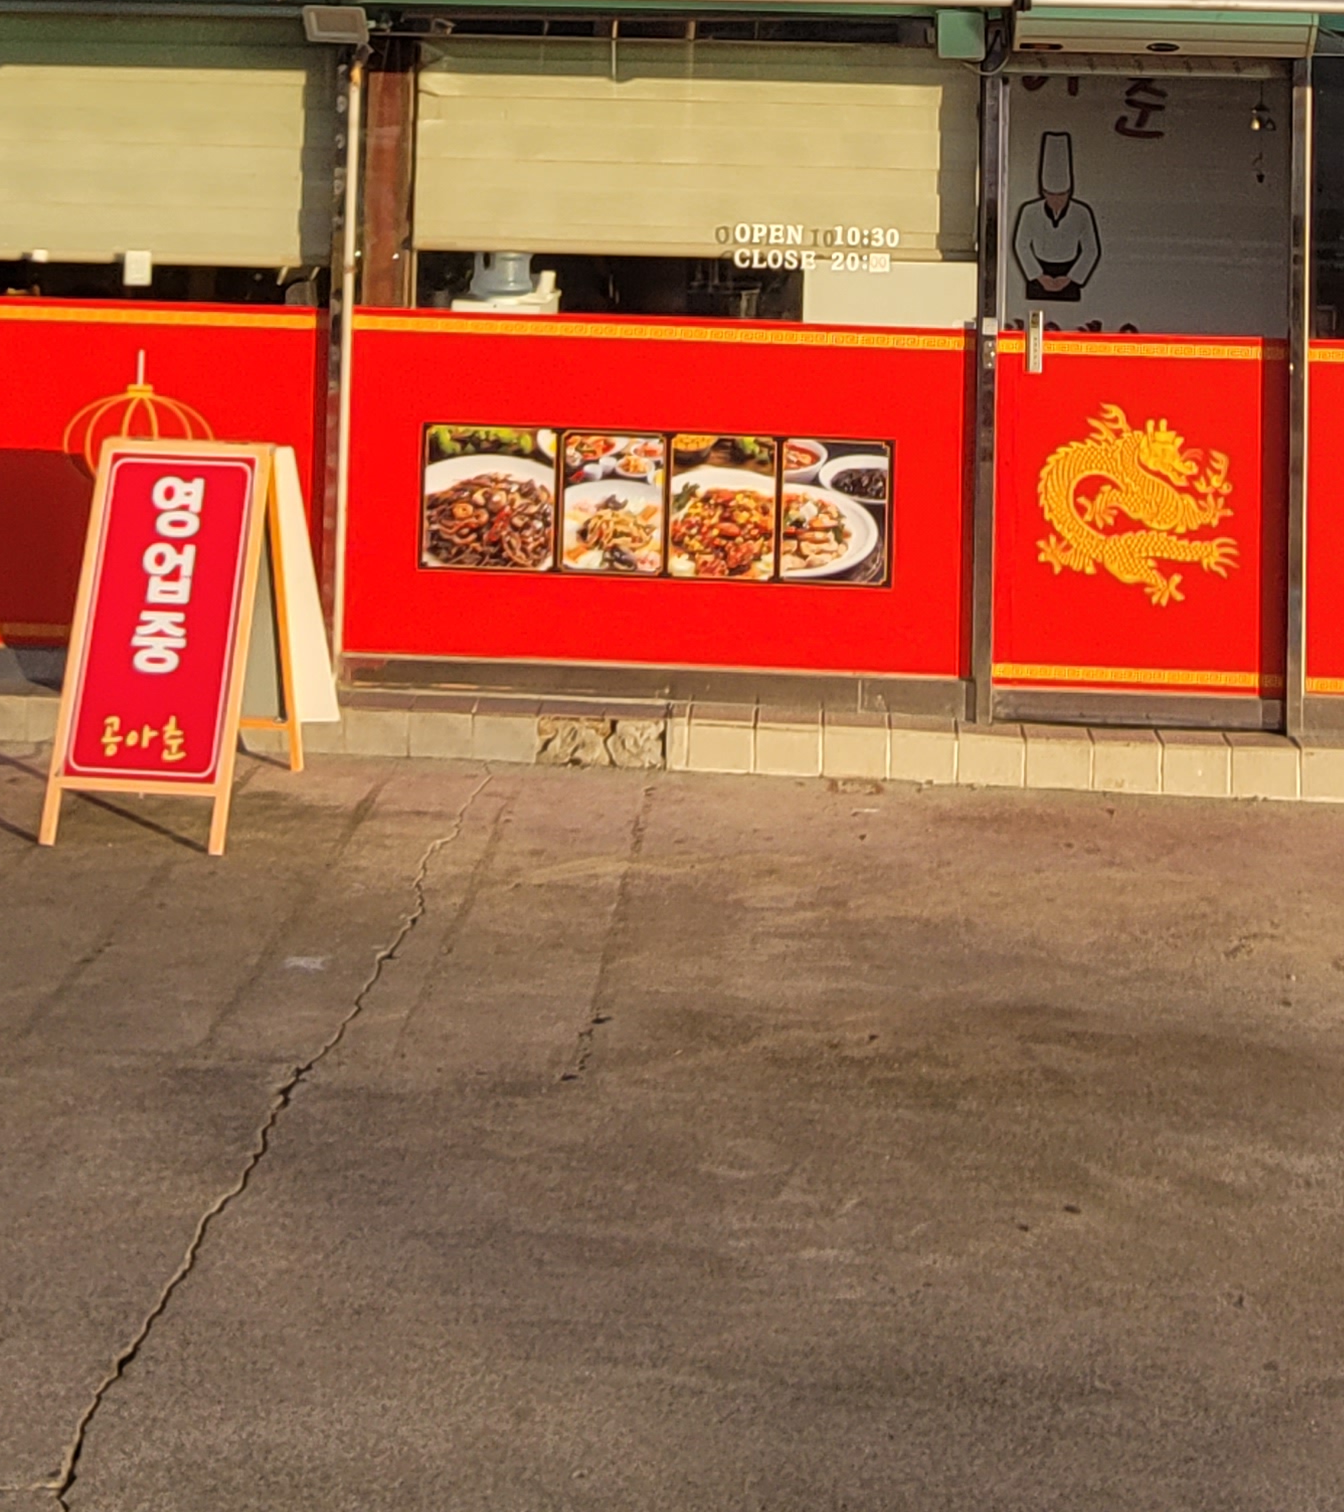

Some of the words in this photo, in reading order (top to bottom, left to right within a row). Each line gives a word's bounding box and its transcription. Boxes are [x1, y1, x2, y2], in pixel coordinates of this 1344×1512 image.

[734, 223, 804, 245] OPEN
[834, 225, 900, 248] 10:30
[733, 248, 816, 270] CLOSE
[130, 476, 205, 675] 영업중
[101, 715, 187, 761] 공아춘
